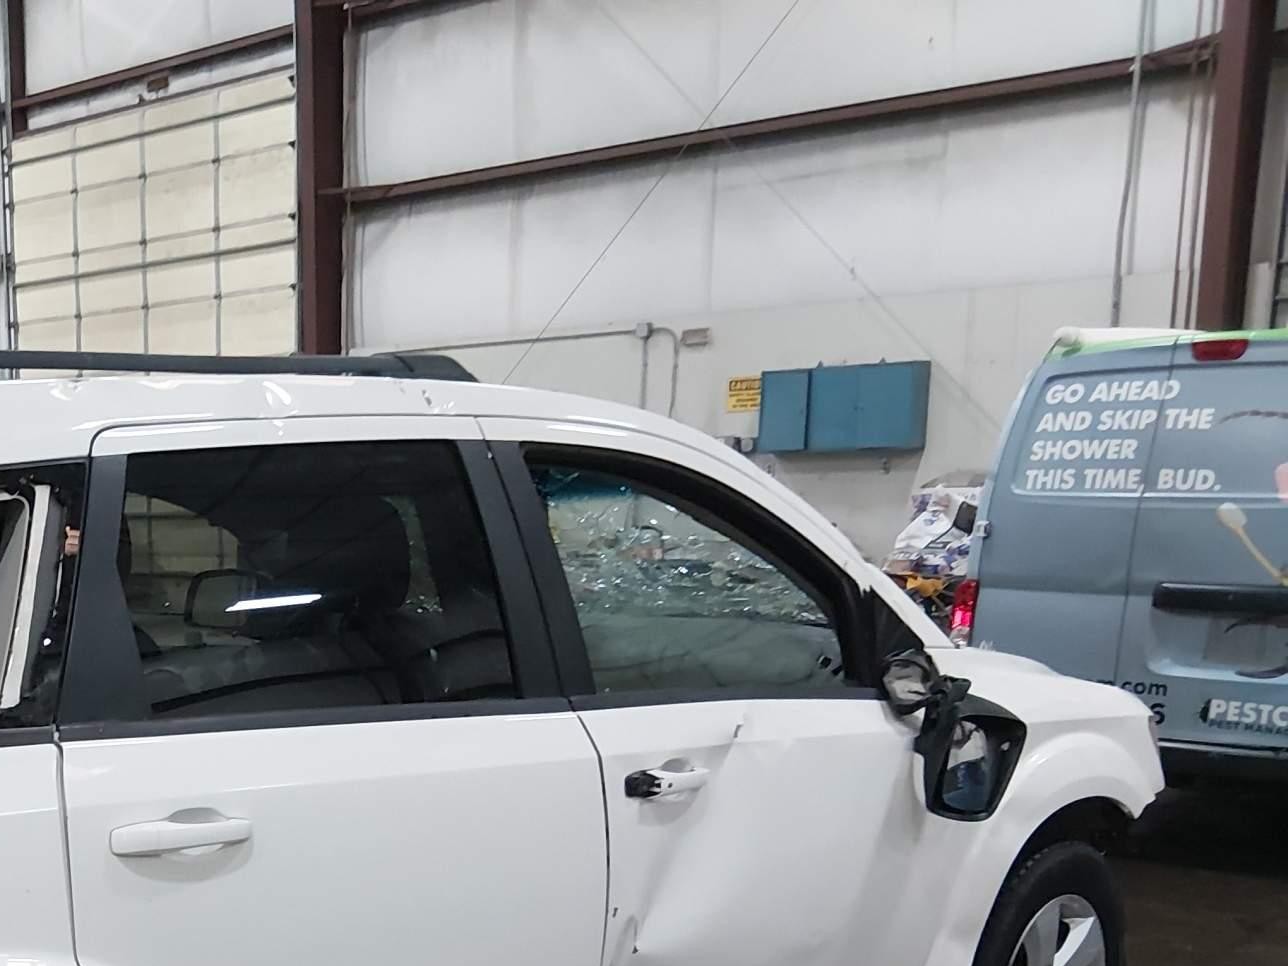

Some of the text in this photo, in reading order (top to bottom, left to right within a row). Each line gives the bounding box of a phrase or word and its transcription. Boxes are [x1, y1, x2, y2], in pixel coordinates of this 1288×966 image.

[1045, 379, 1181, 405] GO AHEAD
[1035, 408, 1216, 433] AND SKIP THE
[1030, 438, 1138, 461] SHOWER
[1025, 468, 1222, 494] THIS TIME, BUD.
